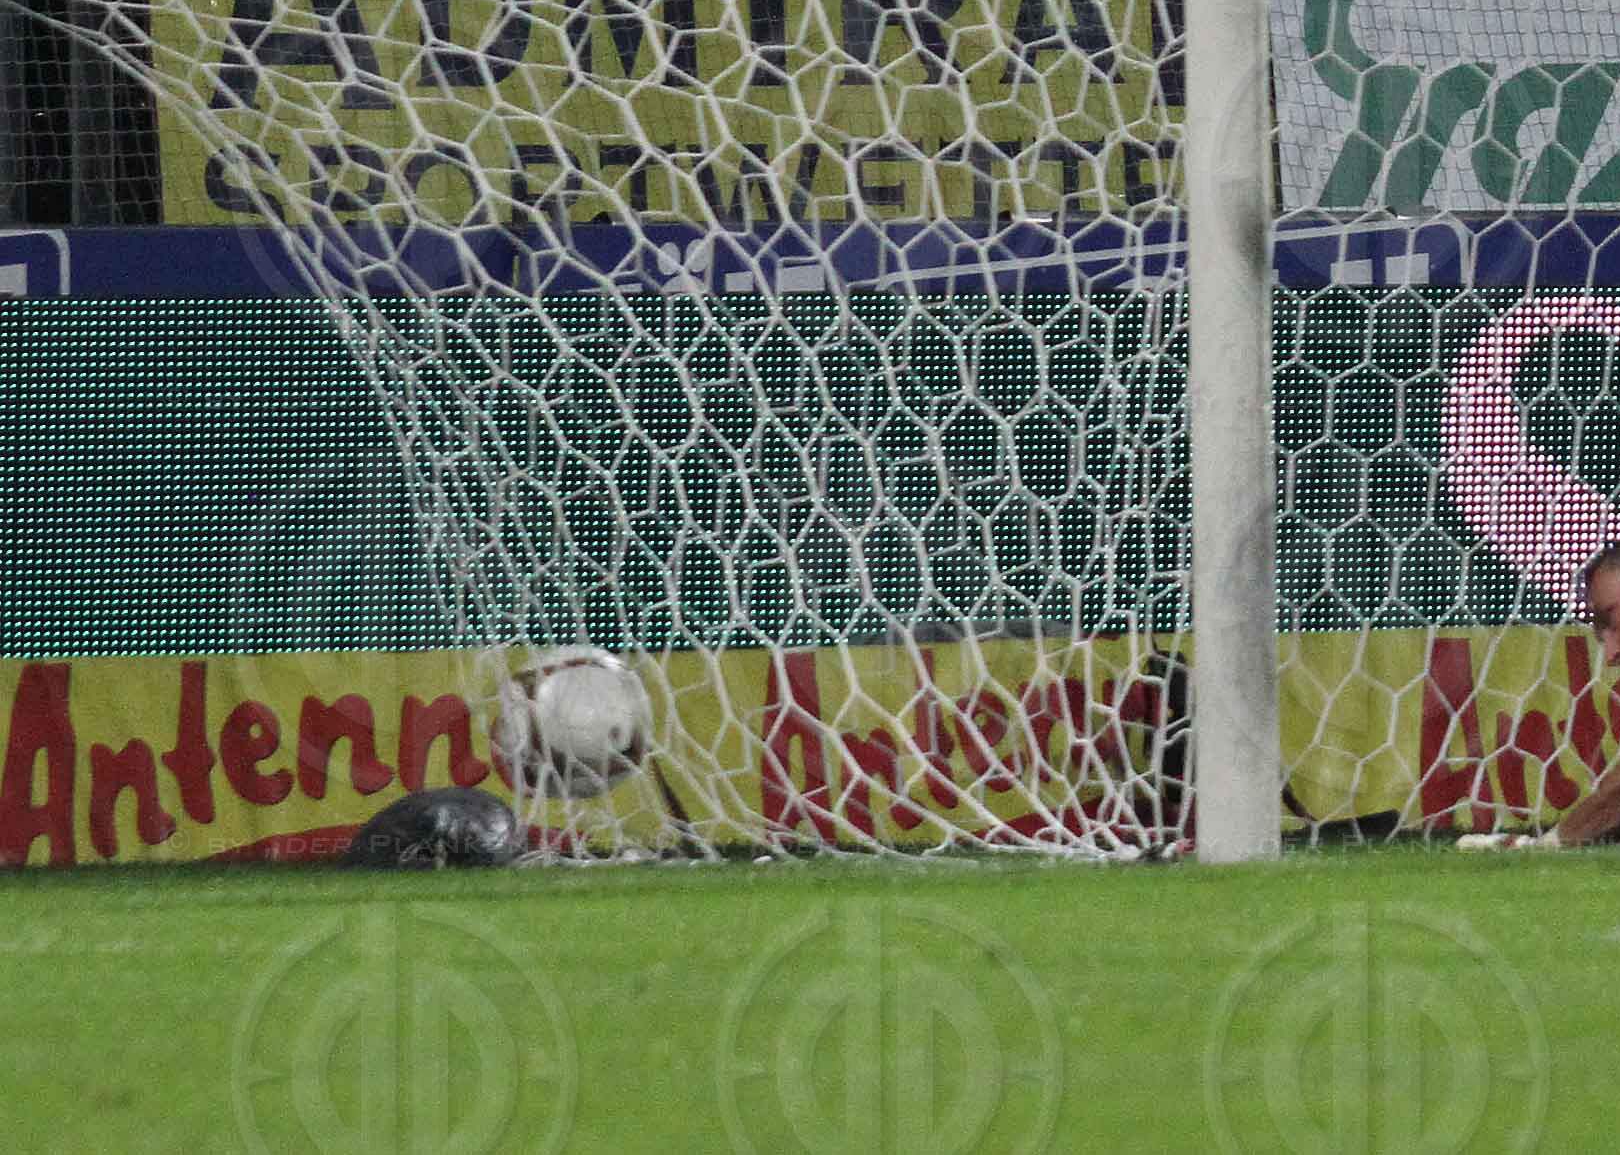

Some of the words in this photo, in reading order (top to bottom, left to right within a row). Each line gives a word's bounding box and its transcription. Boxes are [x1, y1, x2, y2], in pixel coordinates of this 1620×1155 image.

[205, 143, 1190, 227] SPORTWETTE
[2, 661, 530, 869] Antenn
[762, 651, 1168, 849] Antenn
